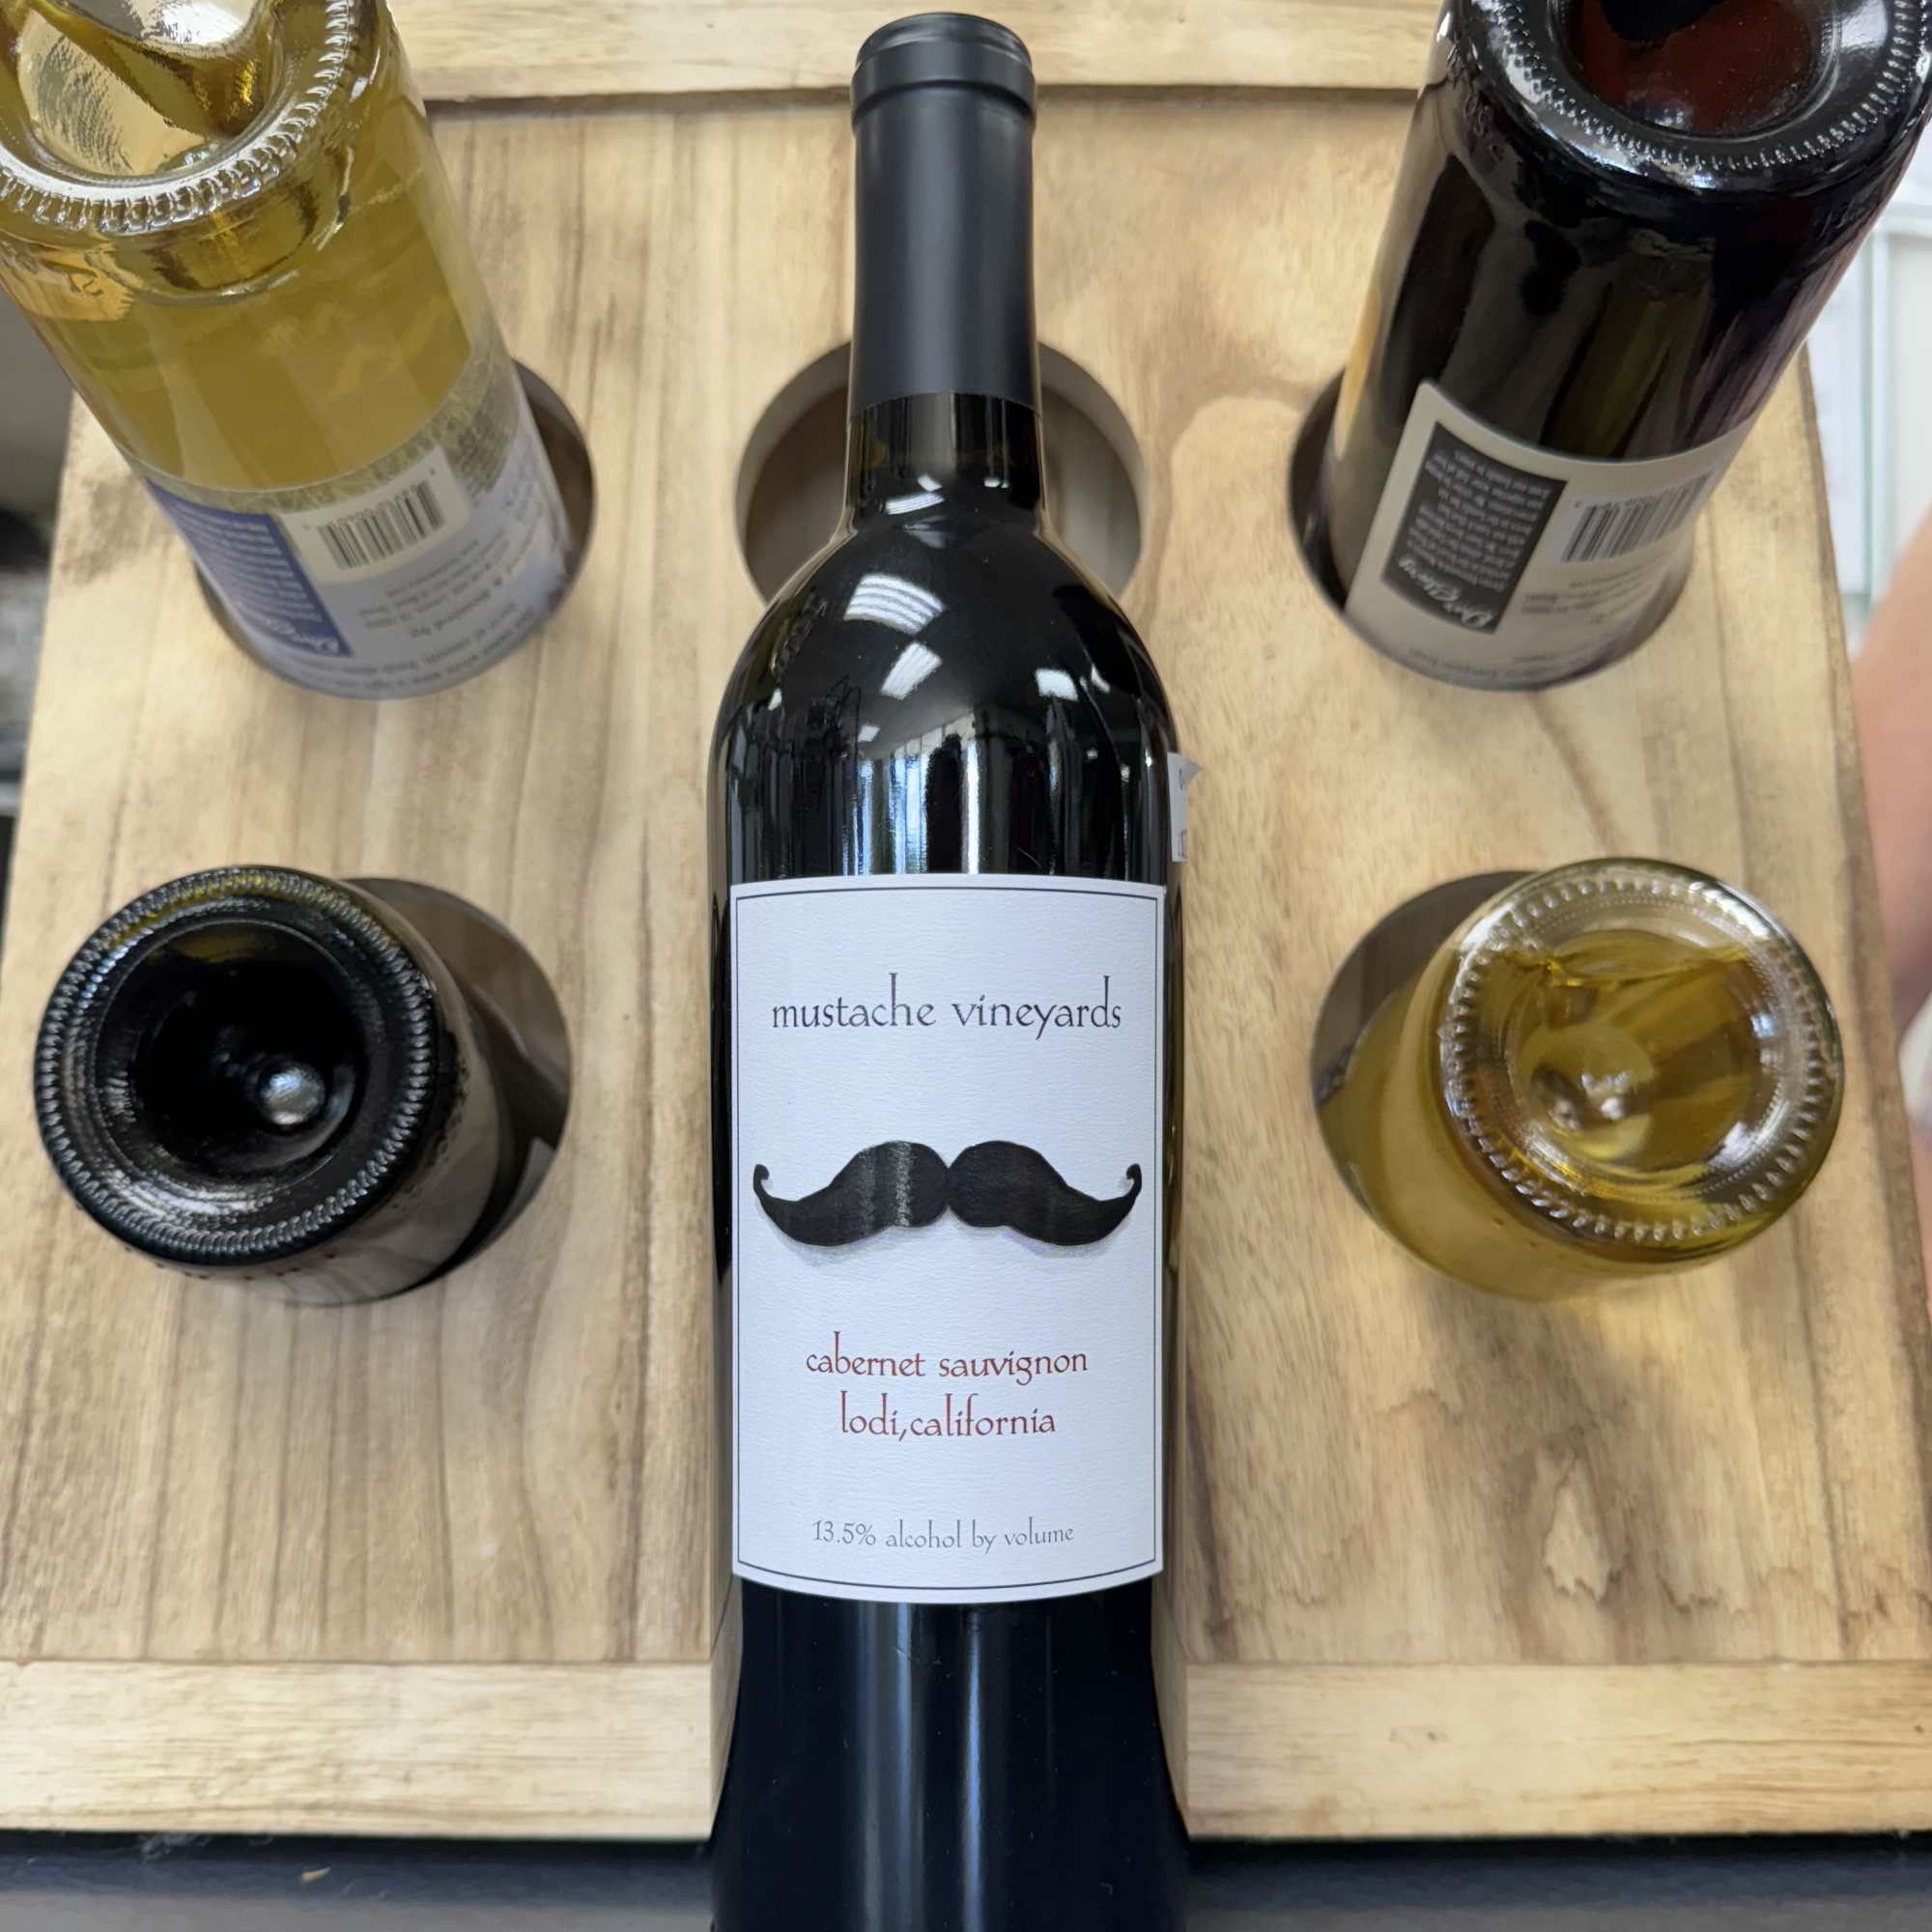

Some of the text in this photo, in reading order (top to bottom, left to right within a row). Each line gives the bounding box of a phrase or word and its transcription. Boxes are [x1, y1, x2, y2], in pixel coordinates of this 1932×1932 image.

[772, 972, 1122, 1041] mustache vineyards
[806, 1330, 1089, 1386] cabernet sauvignon
[812, 1516, 1074, 1553] 13.5% alcohol by volume
